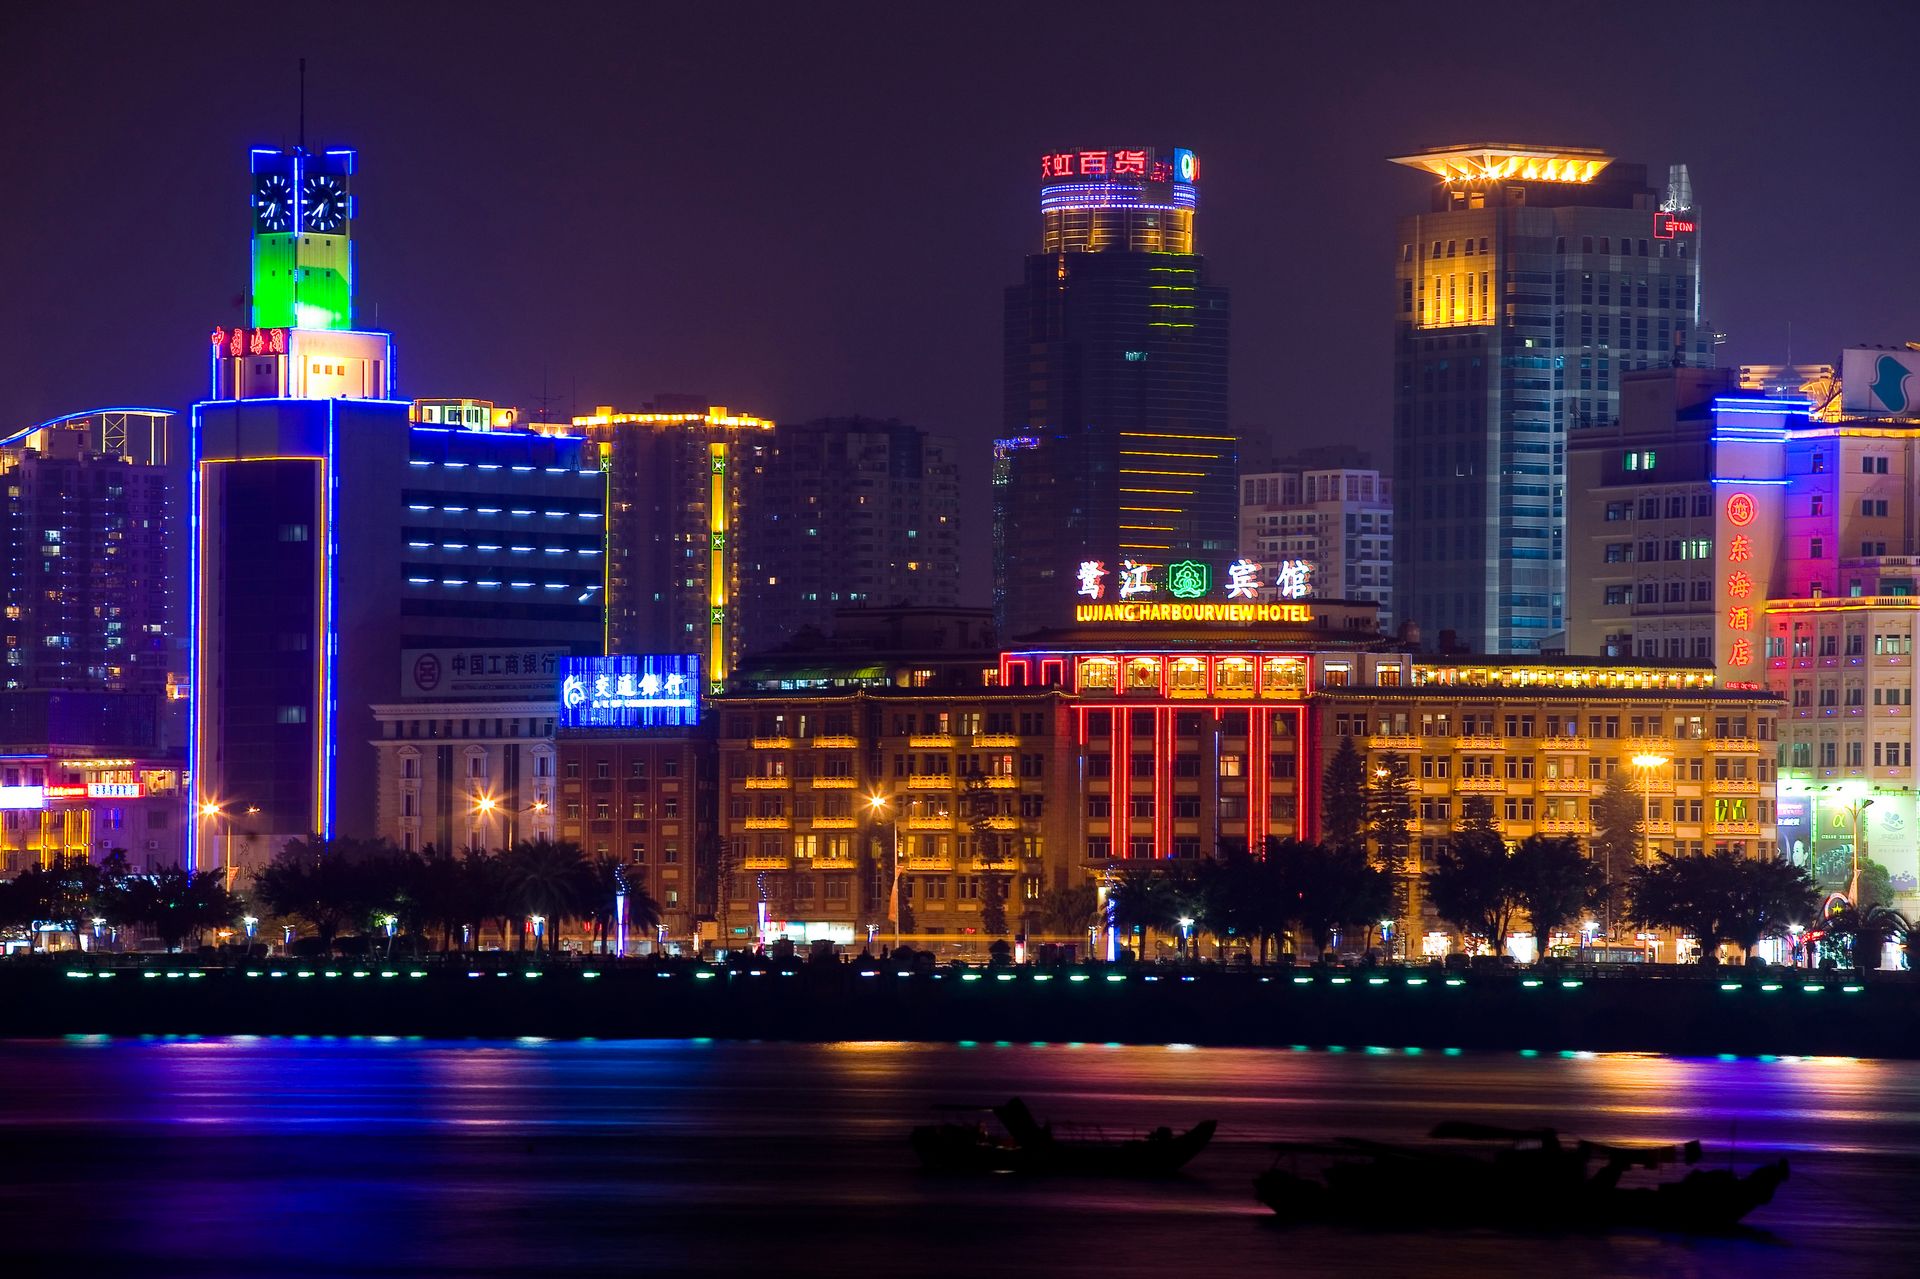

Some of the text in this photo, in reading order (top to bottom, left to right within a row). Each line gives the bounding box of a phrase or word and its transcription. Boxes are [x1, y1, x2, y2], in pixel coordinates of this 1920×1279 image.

[1042, 150, 1146, 178] 天虹百货
[1077, 604, 1310, 622] LUJIANG HARBOURVIEW HOTEL
[1728, 535, 1751, 666] 东海酒店
[451, 653, 556, 675] 中国工商银行
